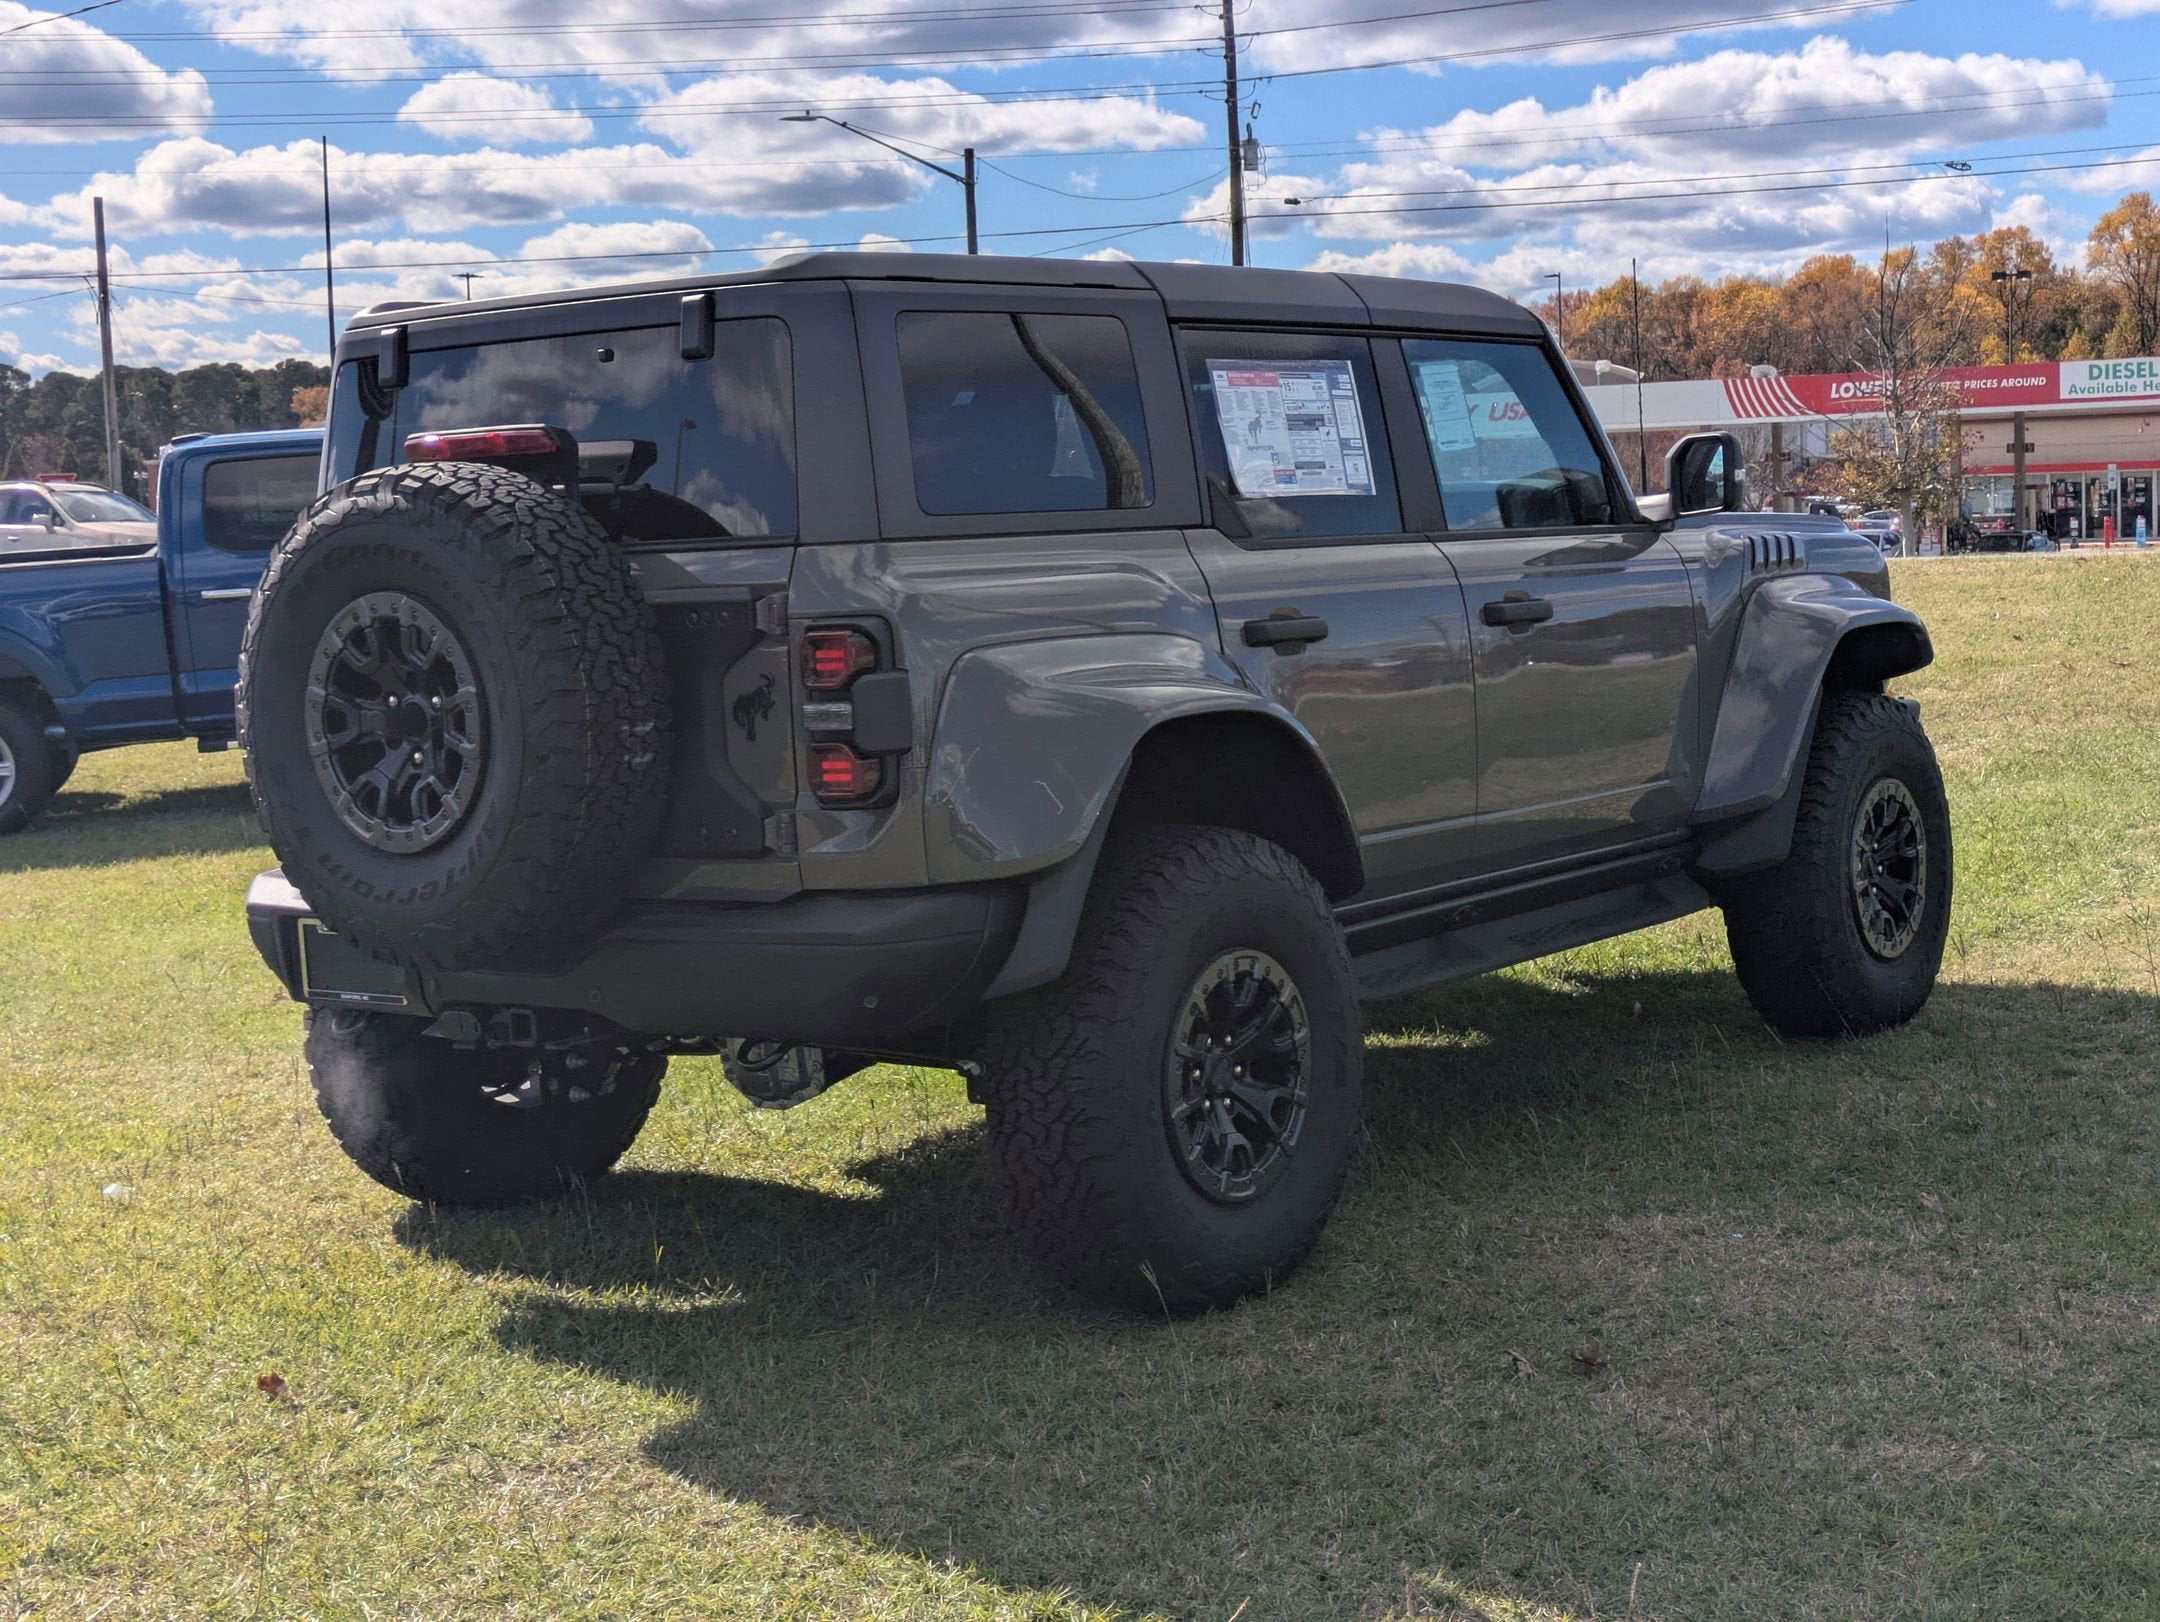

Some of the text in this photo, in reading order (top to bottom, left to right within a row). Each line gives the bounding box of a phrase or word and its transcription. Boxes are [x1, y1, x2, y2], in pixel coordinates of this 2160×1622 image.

[2088, 360, 2159, 381] DIESEL
[1964, 378, 1998, 390] PRICES
[2000, 376, 2047, 388] AROUND
[2068, 381, 2137, 395] Available
